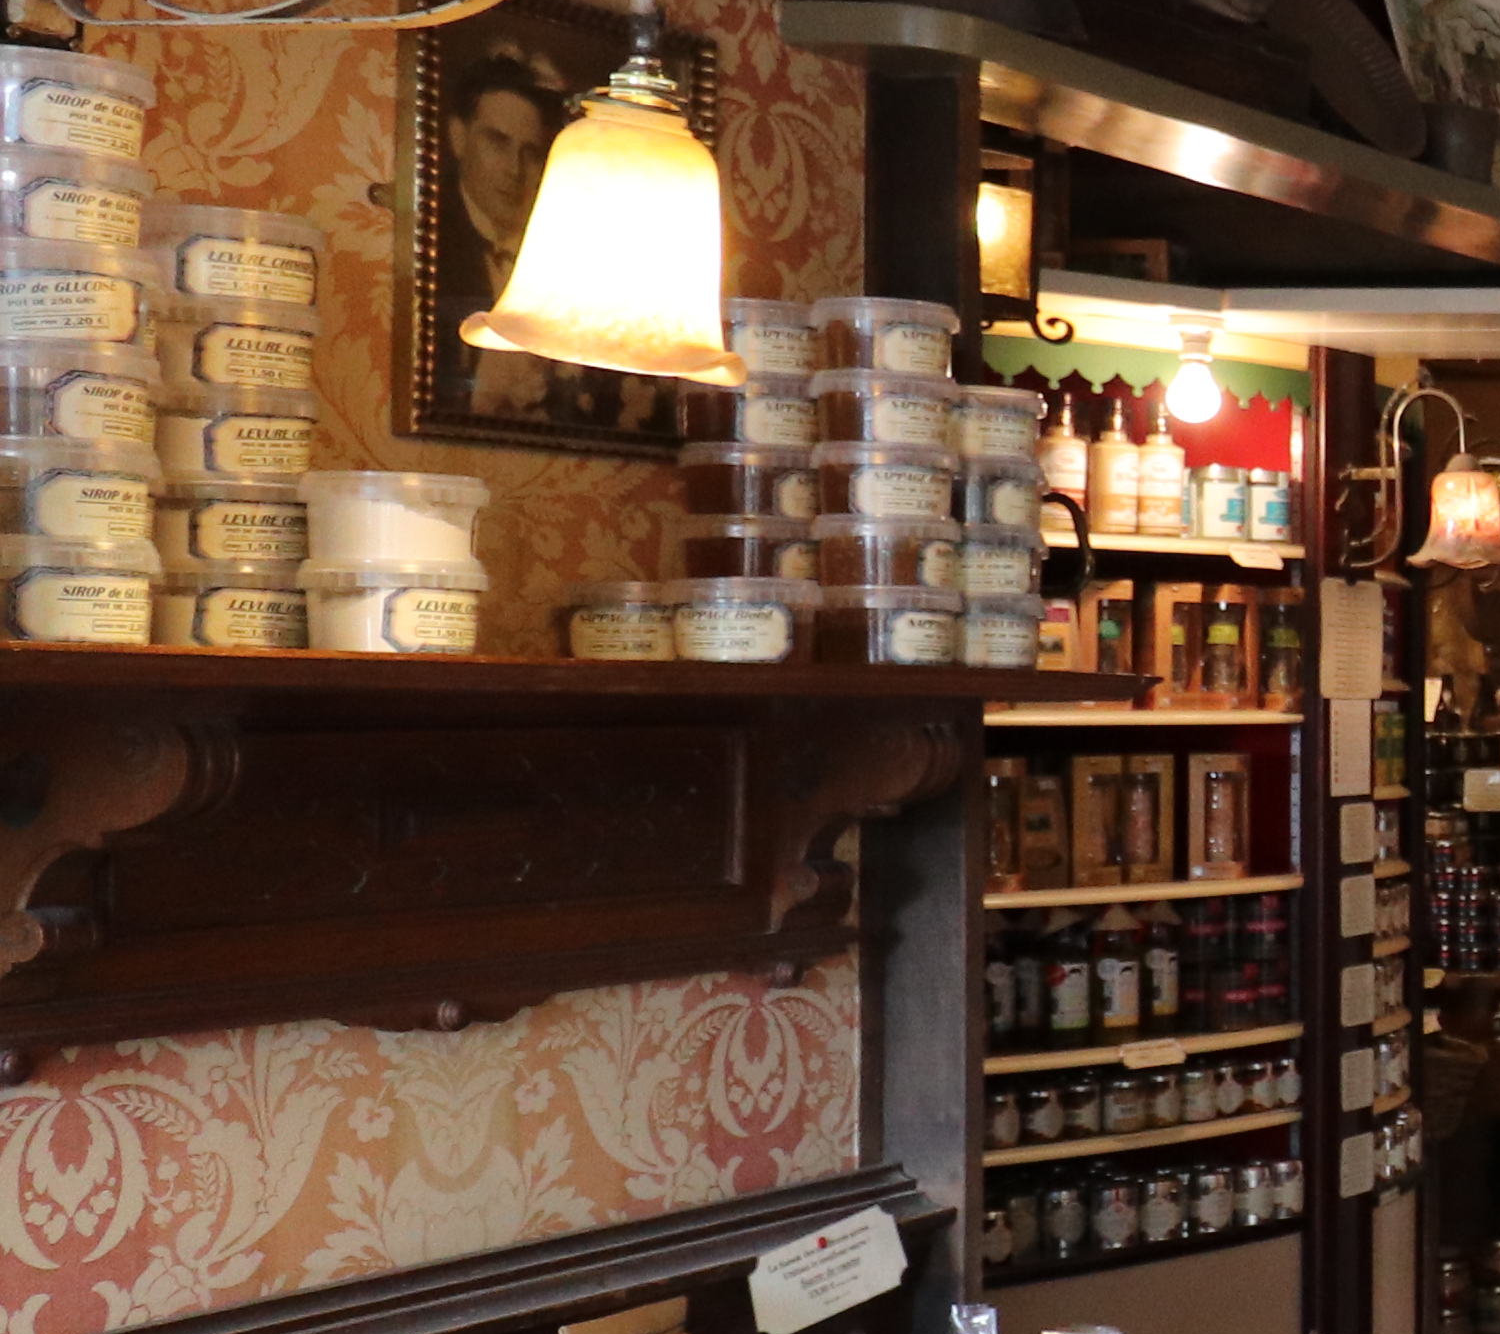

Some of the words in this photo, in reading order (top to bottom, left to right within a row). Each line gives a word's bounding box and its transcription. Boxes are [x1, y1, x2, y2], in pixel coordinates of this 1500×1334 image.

[46, 93, 91, 108] SIROP
[94, 101, 108, 112] de
[52, 190, 96, 203] SIROP
[207, 250, 269, 266] LEVURE
[0, 284, 26, 294] ROP
[31, 282, 49, 294] de
[55, 281, 118, 293] GLUCOSE
[227, 337, 284, 352] LEVURE
[83, 386, 122, 398] SIROP
[237, 428, 288, 439] LEVURE
[81, 489, 120, 501] SIROP
[221, 513, 278, 526] LEVURE
[63, 585, 105, 598] SIROP
[229, 599, 287, 612] LEVURE
[415, 600, 463, 612] LEVURE
